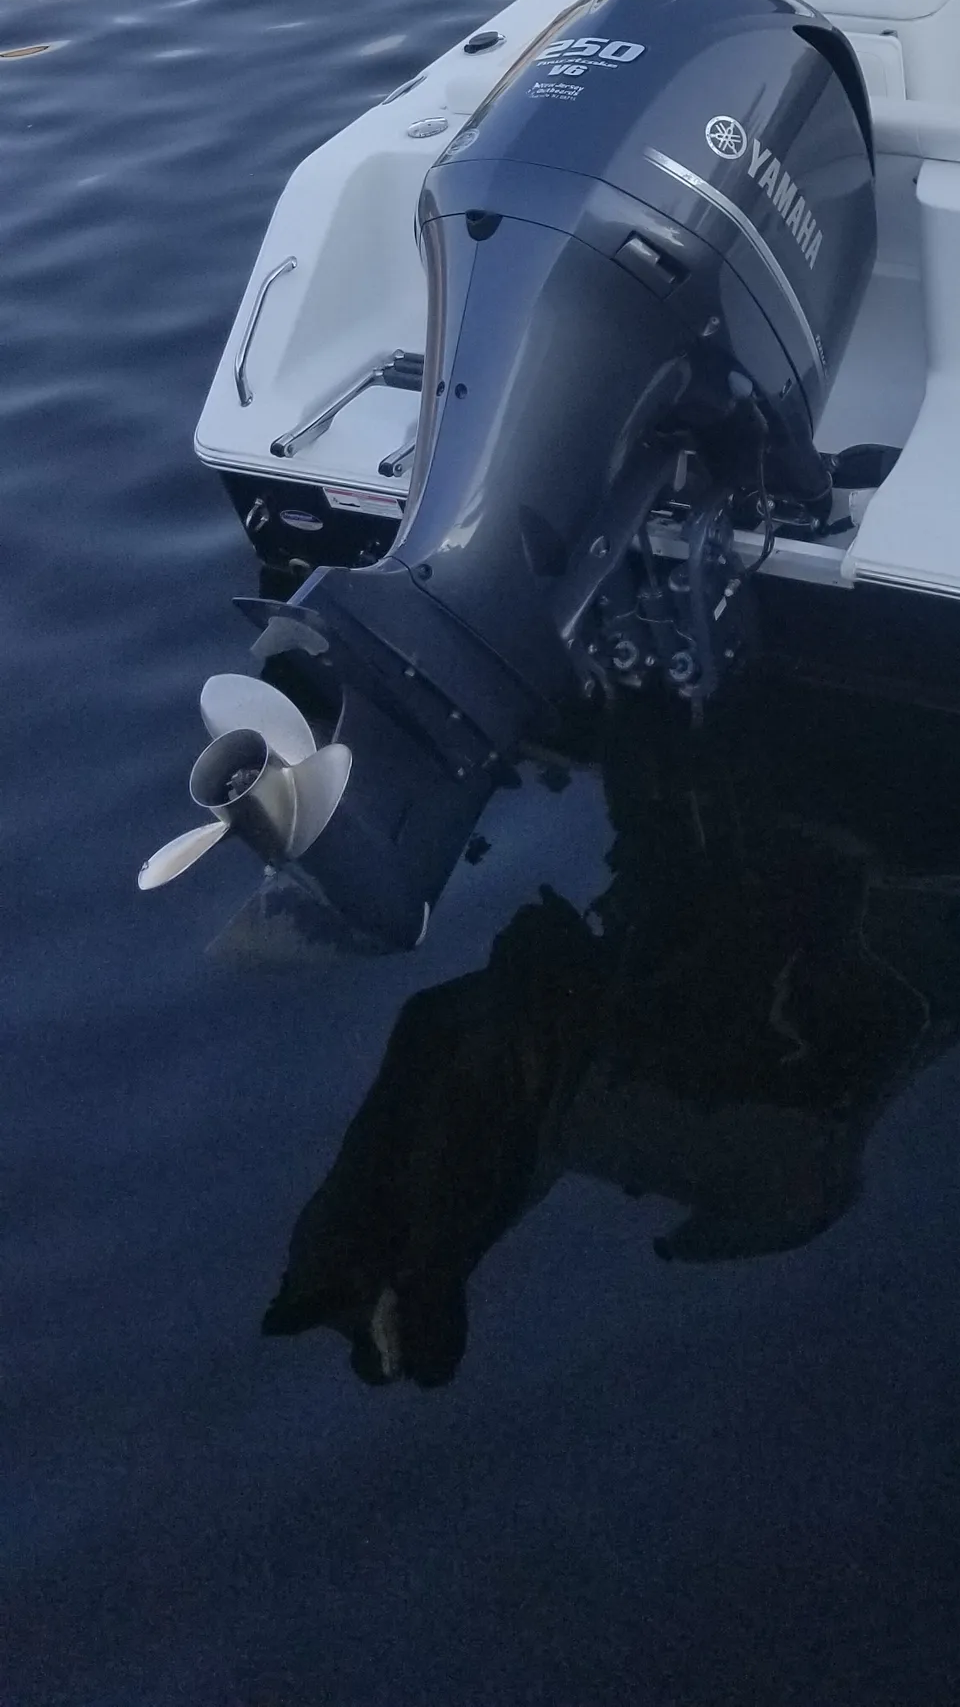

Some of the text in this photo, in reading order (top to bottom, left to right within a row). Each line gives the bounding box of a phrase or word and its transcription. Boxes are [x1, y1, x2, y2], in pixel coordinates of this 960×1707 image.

[535, 37, 645, 62] 250
[547, 64, 588, 76] V6
[747, 138, 823, 271] YAMAHA
